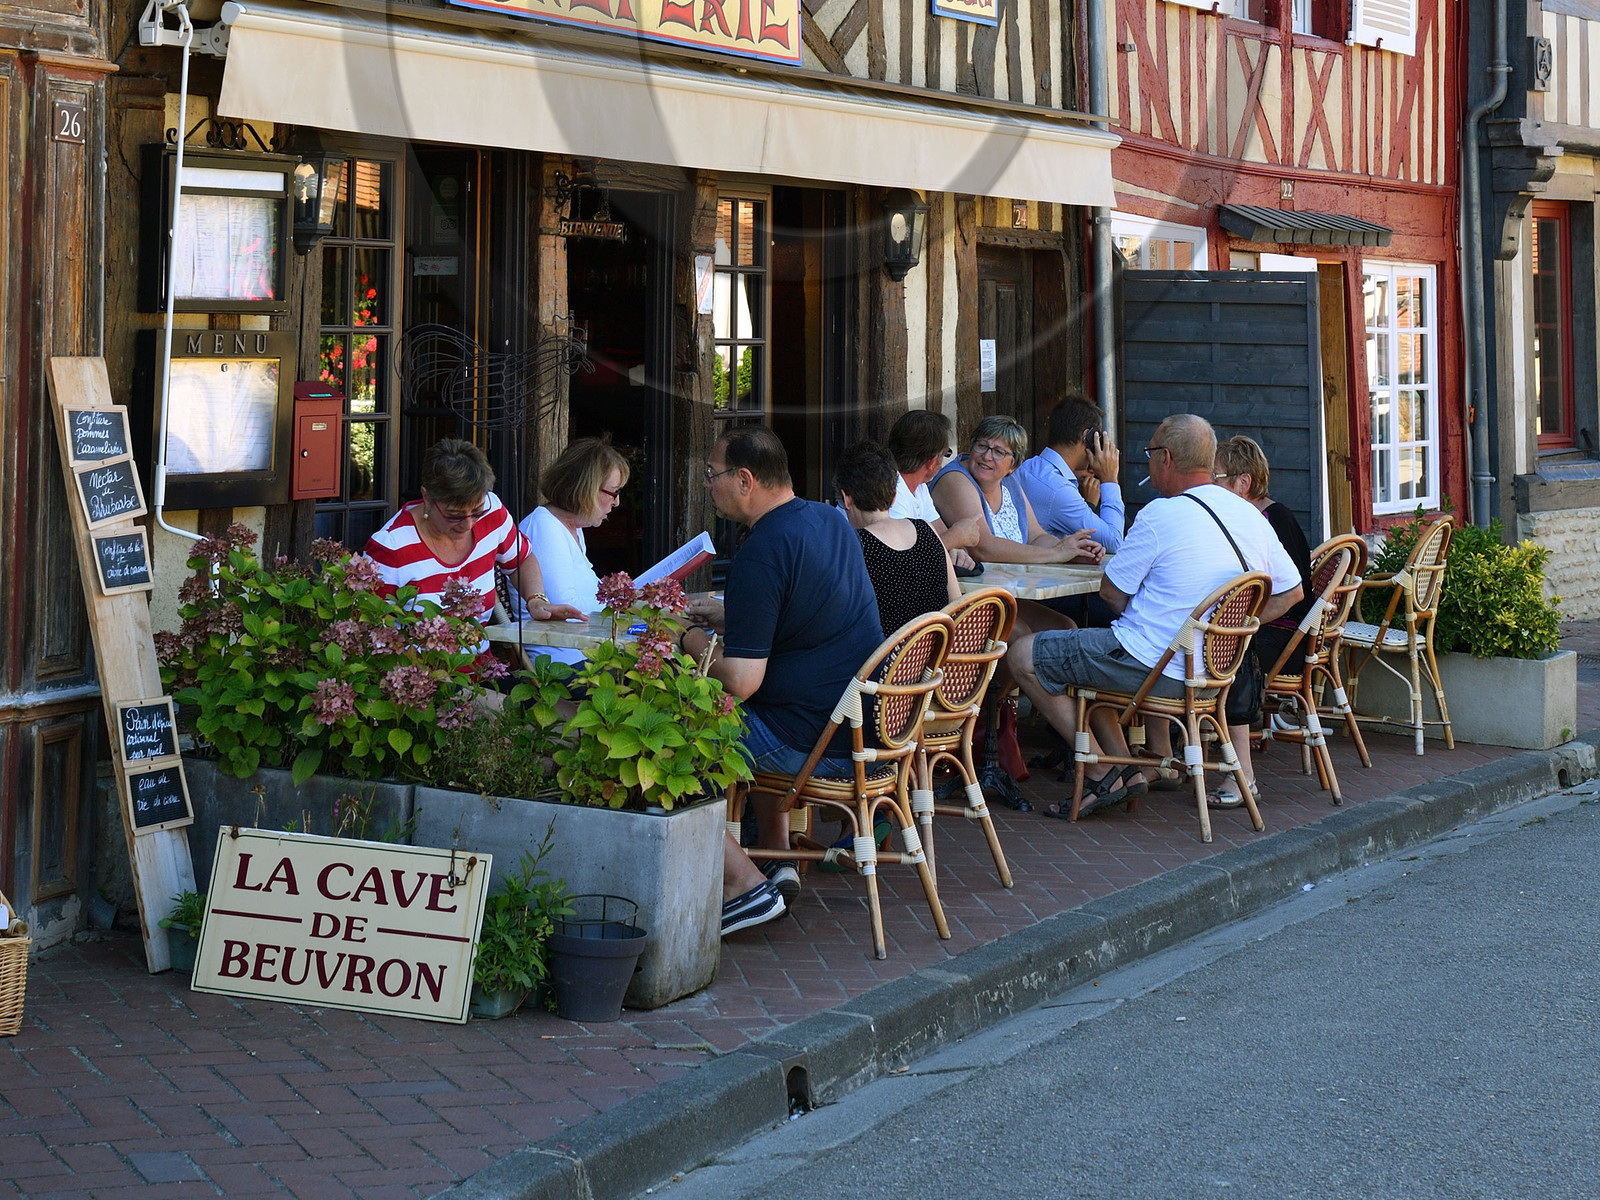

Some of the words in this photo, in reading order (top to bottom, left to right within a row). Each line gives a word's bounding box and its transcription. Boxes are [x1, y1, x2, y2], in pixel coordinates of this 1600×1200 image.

[60, 109, 81, 138] 26
[1283, 182, 1293, 197] 22
[1014, 208, 1027, 226] 24
[560, 220, 624, 240] BIENVENUE
[187, 333, 268, 355] MENU
[89, 468, 124, 489] Nectar
[126, 707, 152, 731] Pain
[232, 852, 300, 896] LA
[316, 862, 458, 914] CAVE
[309, 912, 369, 943] DE
[217, 939, 448, 1003] BEUVRON
